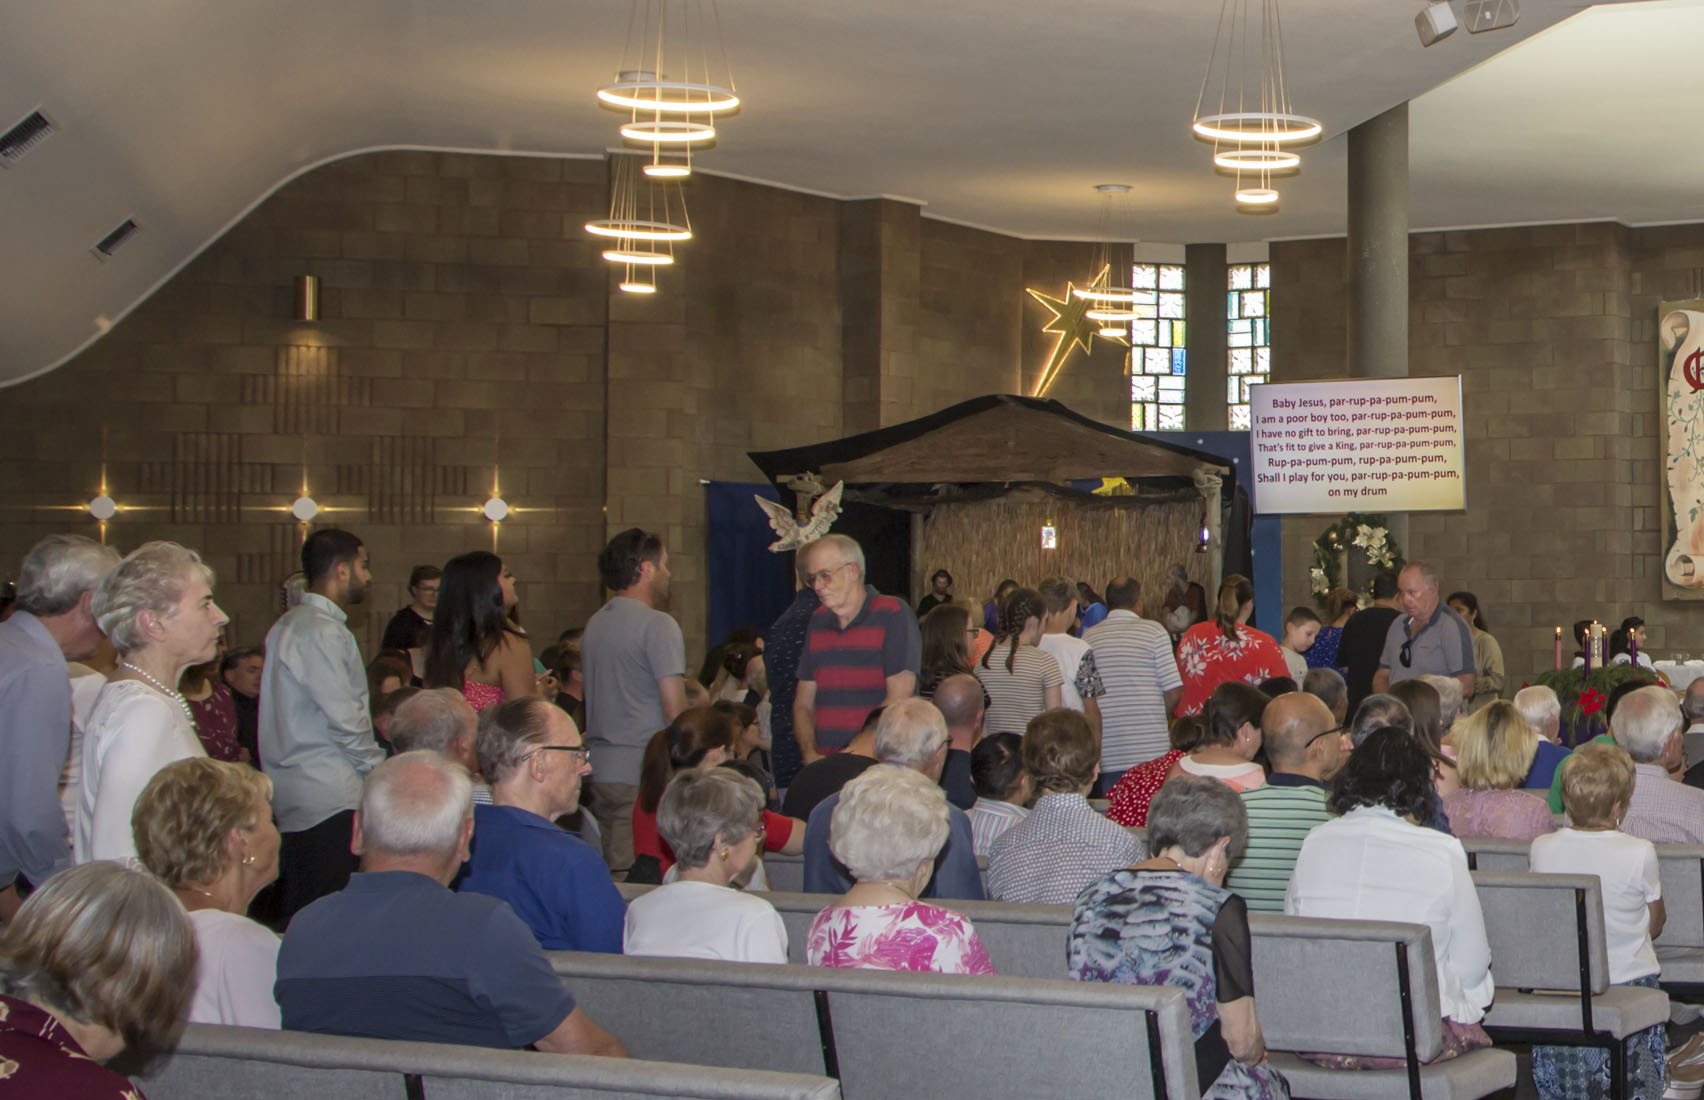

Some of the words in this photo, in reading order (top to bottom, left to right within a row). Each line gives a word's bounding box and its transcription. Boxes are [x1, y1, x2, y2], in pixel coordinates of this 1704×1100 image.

[1273, 398, 1296, 409] Baby
[1299, 398, 1326, 408] Jesus,
[1330, 395, 1437, 407] par-rup-pa-pum-pum,
[1287, 415, 1308, 425] poor
[1311, 412, 1327, 423] boy
[1331, 413, 1349, 423] too,
[1352, 410, 1456, 421] par-rup-pa-pum-pum,
[1262, 429, 1282, 438] have
[1299, 428, 1313, 439] gift
[1316, 429, 1325, 437] to
[1328, 428, 1354, 438] bring,
[1357, 425, 1457, 436] par-rup-pa-pum-pum,
[1286, 443, 1295, 451] fit
[1309, 443, 1326, 452] give
[1336, 441, 1357, 451] King,
[1360, 440, 1456, 450] par-rup-pa-pum-pum,
[1269, 458, 1356, 468] Rup-pa-pum-pum,
[1359, 454, 1447, 466] rup-pa-pum-pum,
[1258, 473, 1280, 482] Shall
[1289, 473, 1308, 483] play
[1312, 472, 1325, 481] for
[1328, 473, 1348, 483] you,
[1352, 471, 1459, 481] par-rup-pa-pum-pum,
[1329, 488, 1340, 496] on
[1344, 488, 1359, 497] my
[1361, 486, 1387, 495] drum
